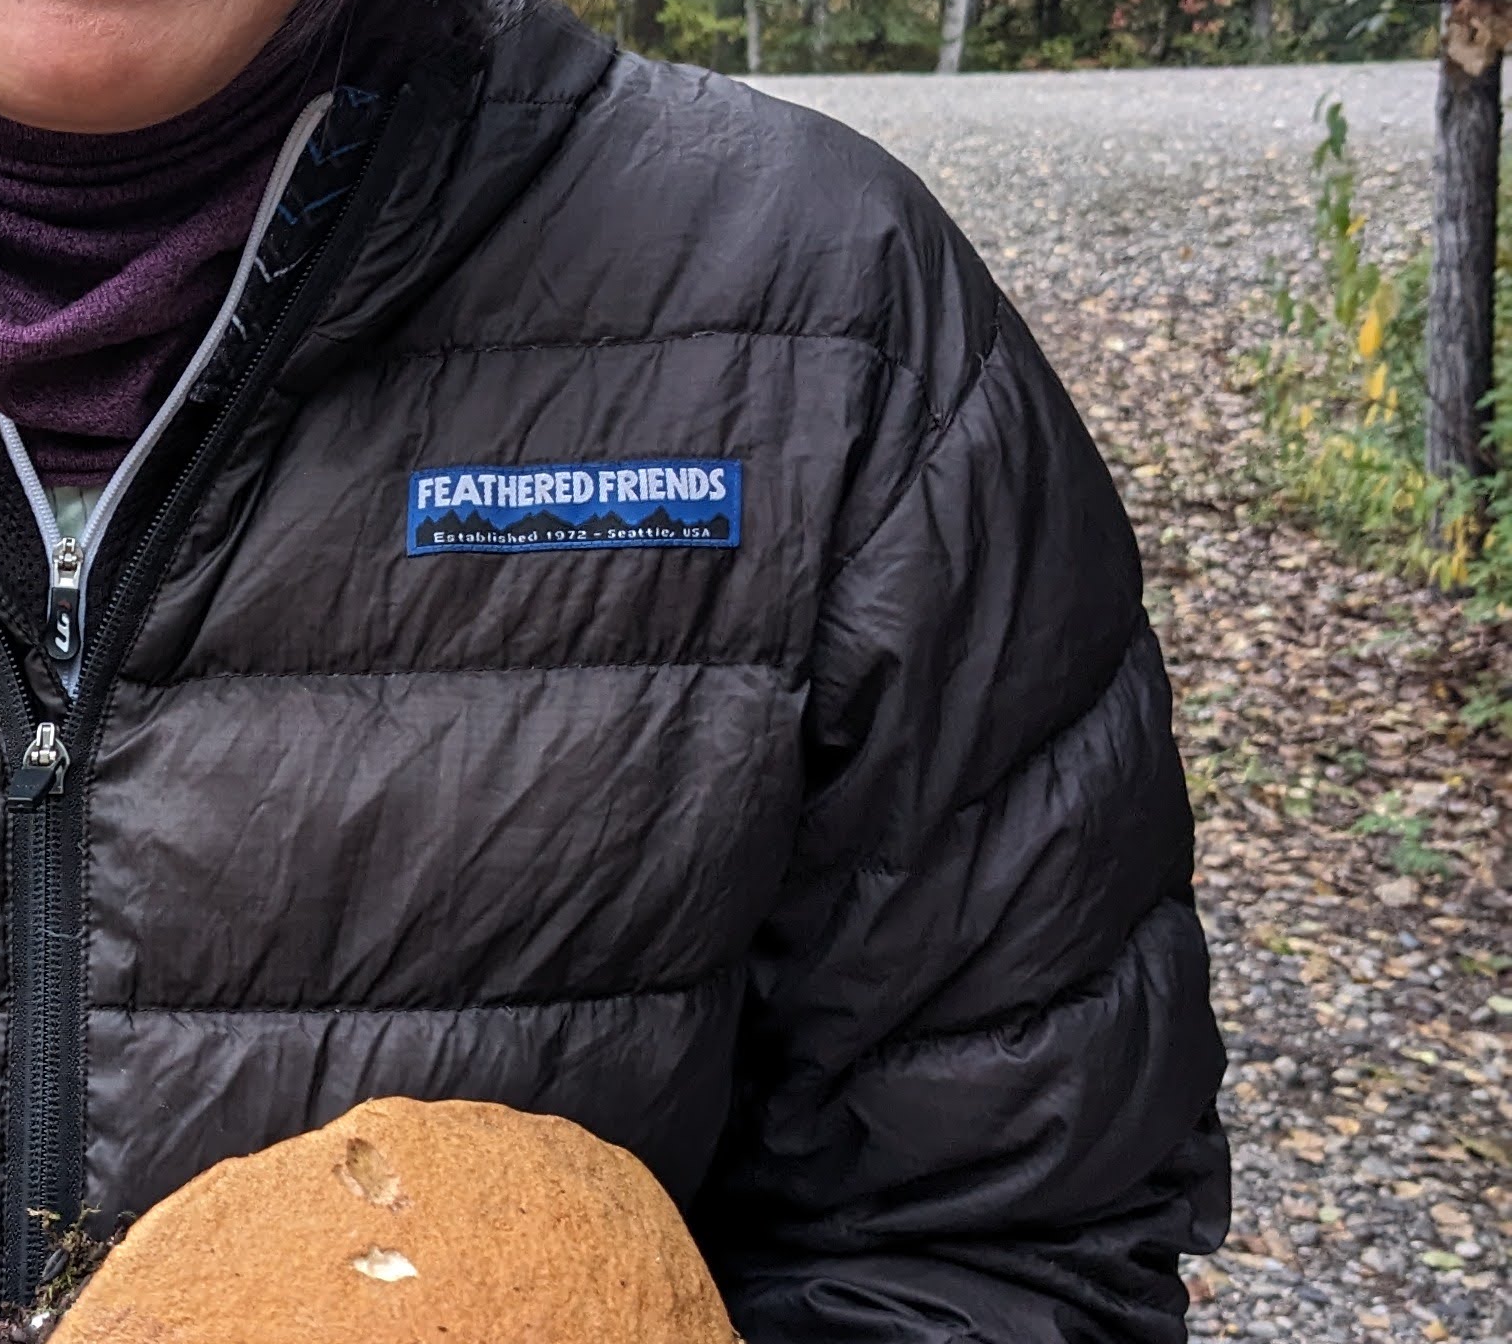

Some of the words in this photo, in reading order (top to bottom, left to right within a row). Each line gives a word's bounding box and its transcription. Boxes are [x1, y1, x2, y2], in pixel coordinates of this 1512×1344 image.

[417, 471, 594, 509] FEATHERED
[598, 467, 727, 503] FRIENDS
[433, 531, 538, 544] Established
[546, 530, 587, 541] 1972
[682, 527, 711, 538] USA
